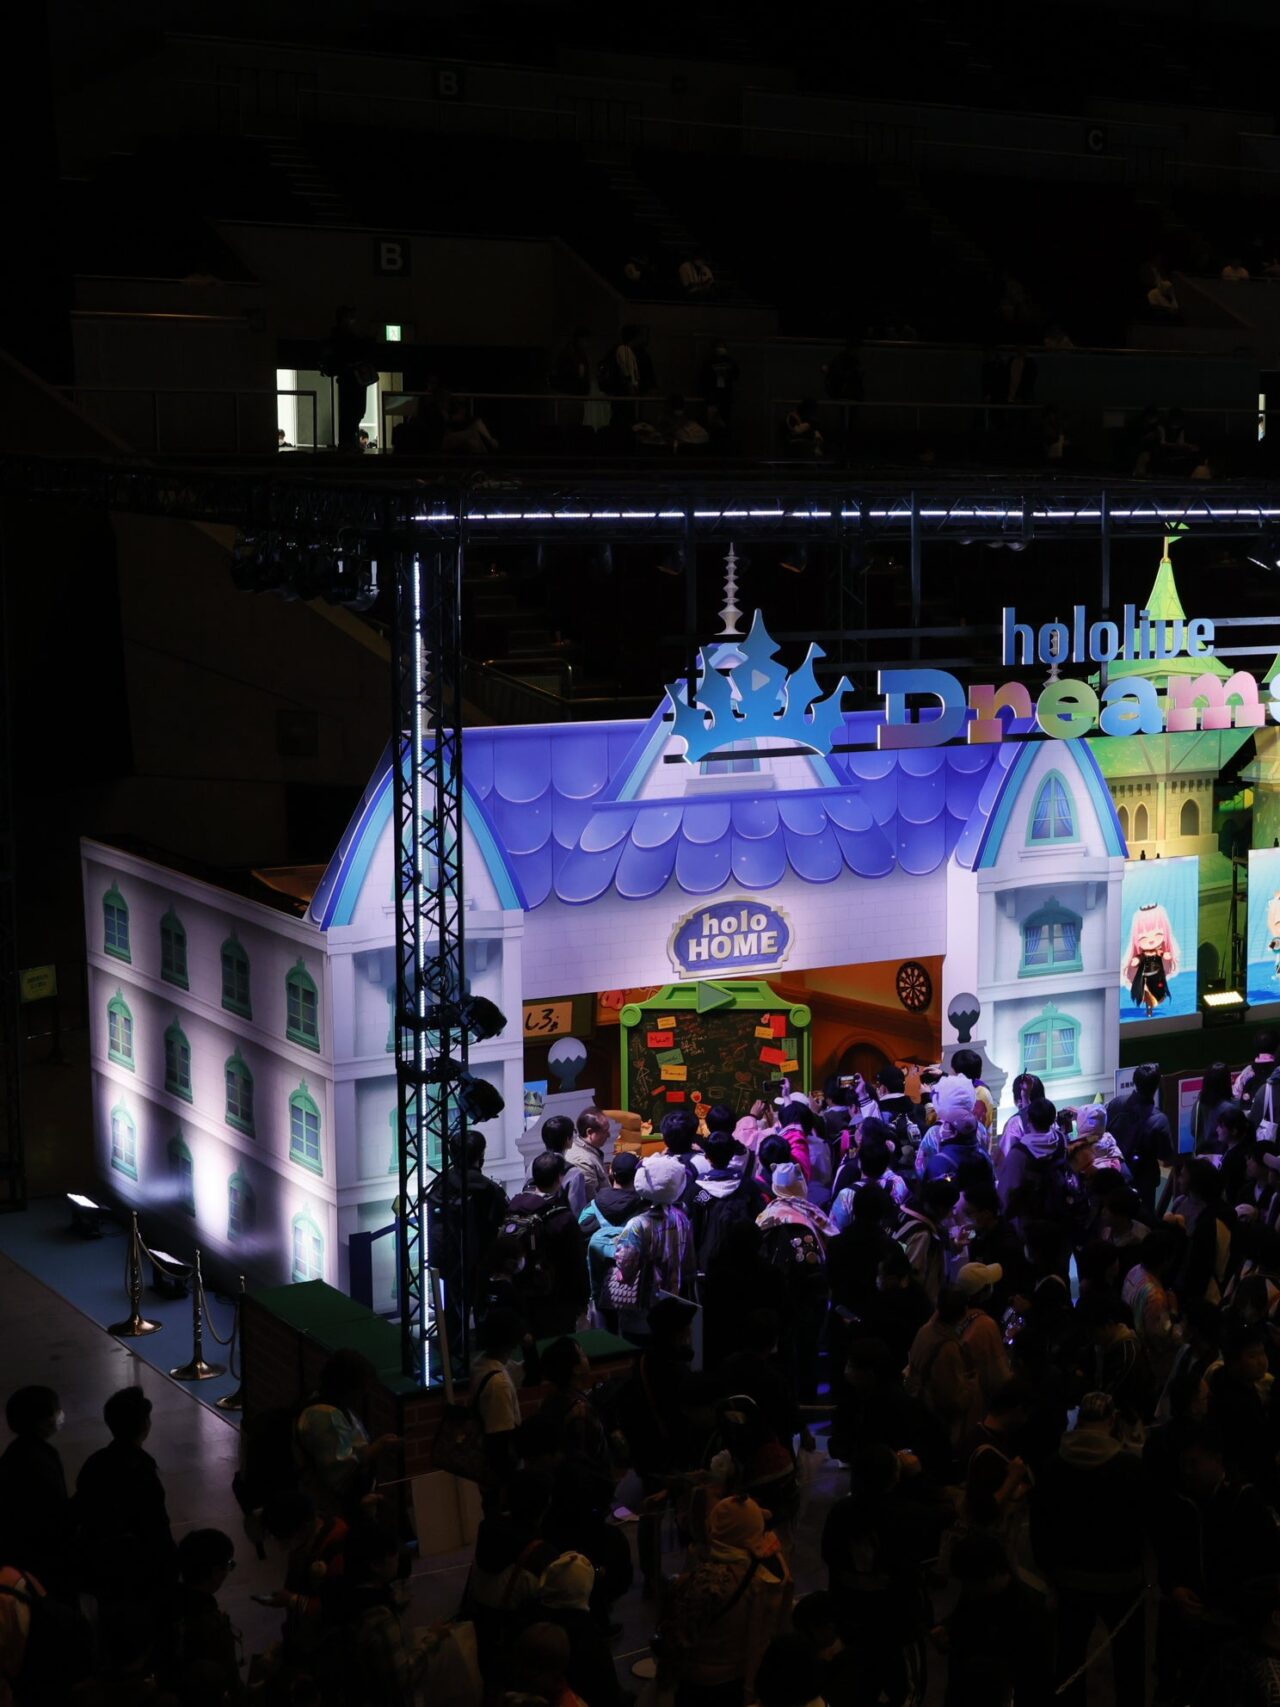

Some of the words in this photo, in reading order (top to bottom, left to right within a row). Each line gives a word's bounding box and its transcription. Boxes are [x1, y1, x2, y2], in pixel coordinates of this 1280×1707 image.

[439, 71, 458, 95] B
[1089, 129, 1104, 151] C
[381, 242, 403, 270] B
[1002, 603, 1216, 666] hololive
[702, 909, 768, 936] holo
[688, 931, 778, 961] HOME
